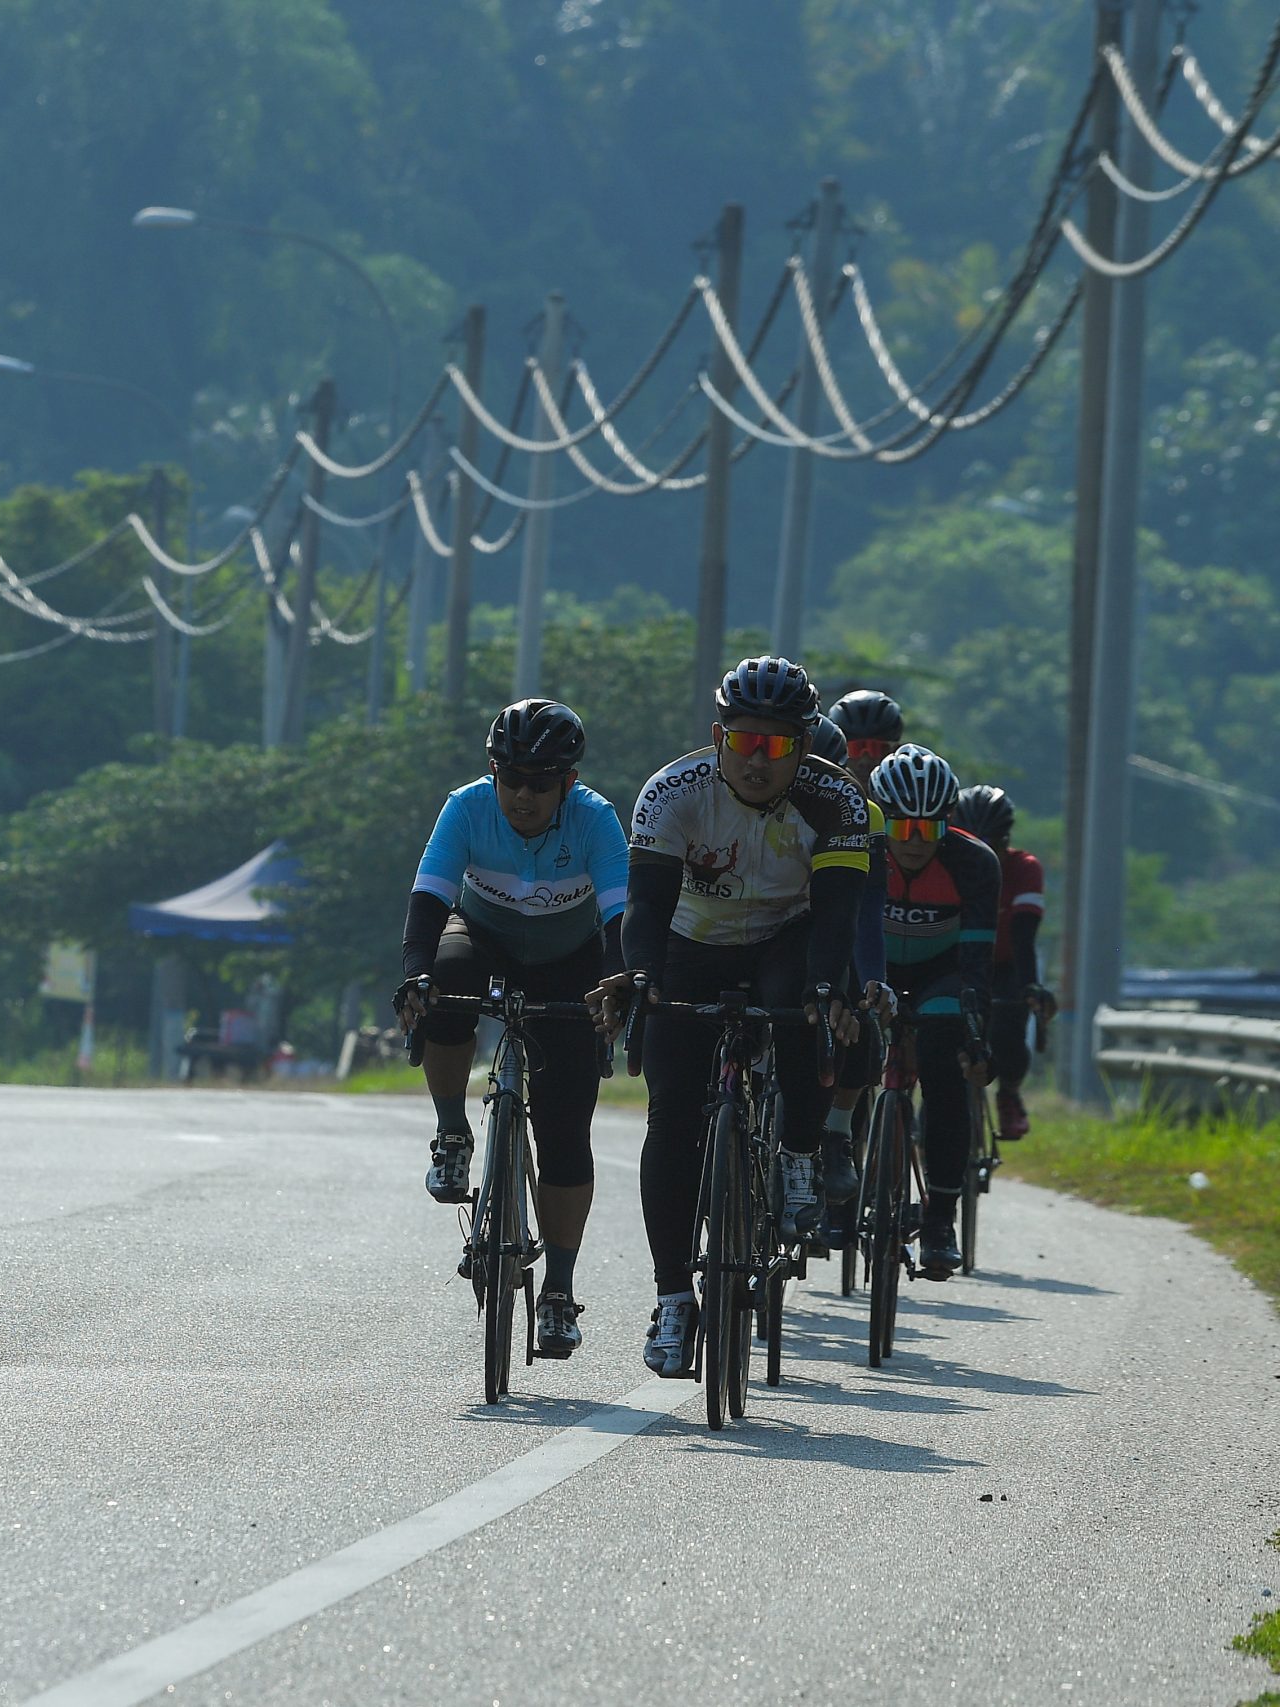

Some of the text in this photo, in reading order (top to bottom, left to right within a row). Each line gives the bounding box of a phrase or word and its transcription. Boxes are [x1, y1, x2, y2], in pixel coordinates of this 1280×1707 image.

[647, 776, 715, 830] PRO BKE FITTER
